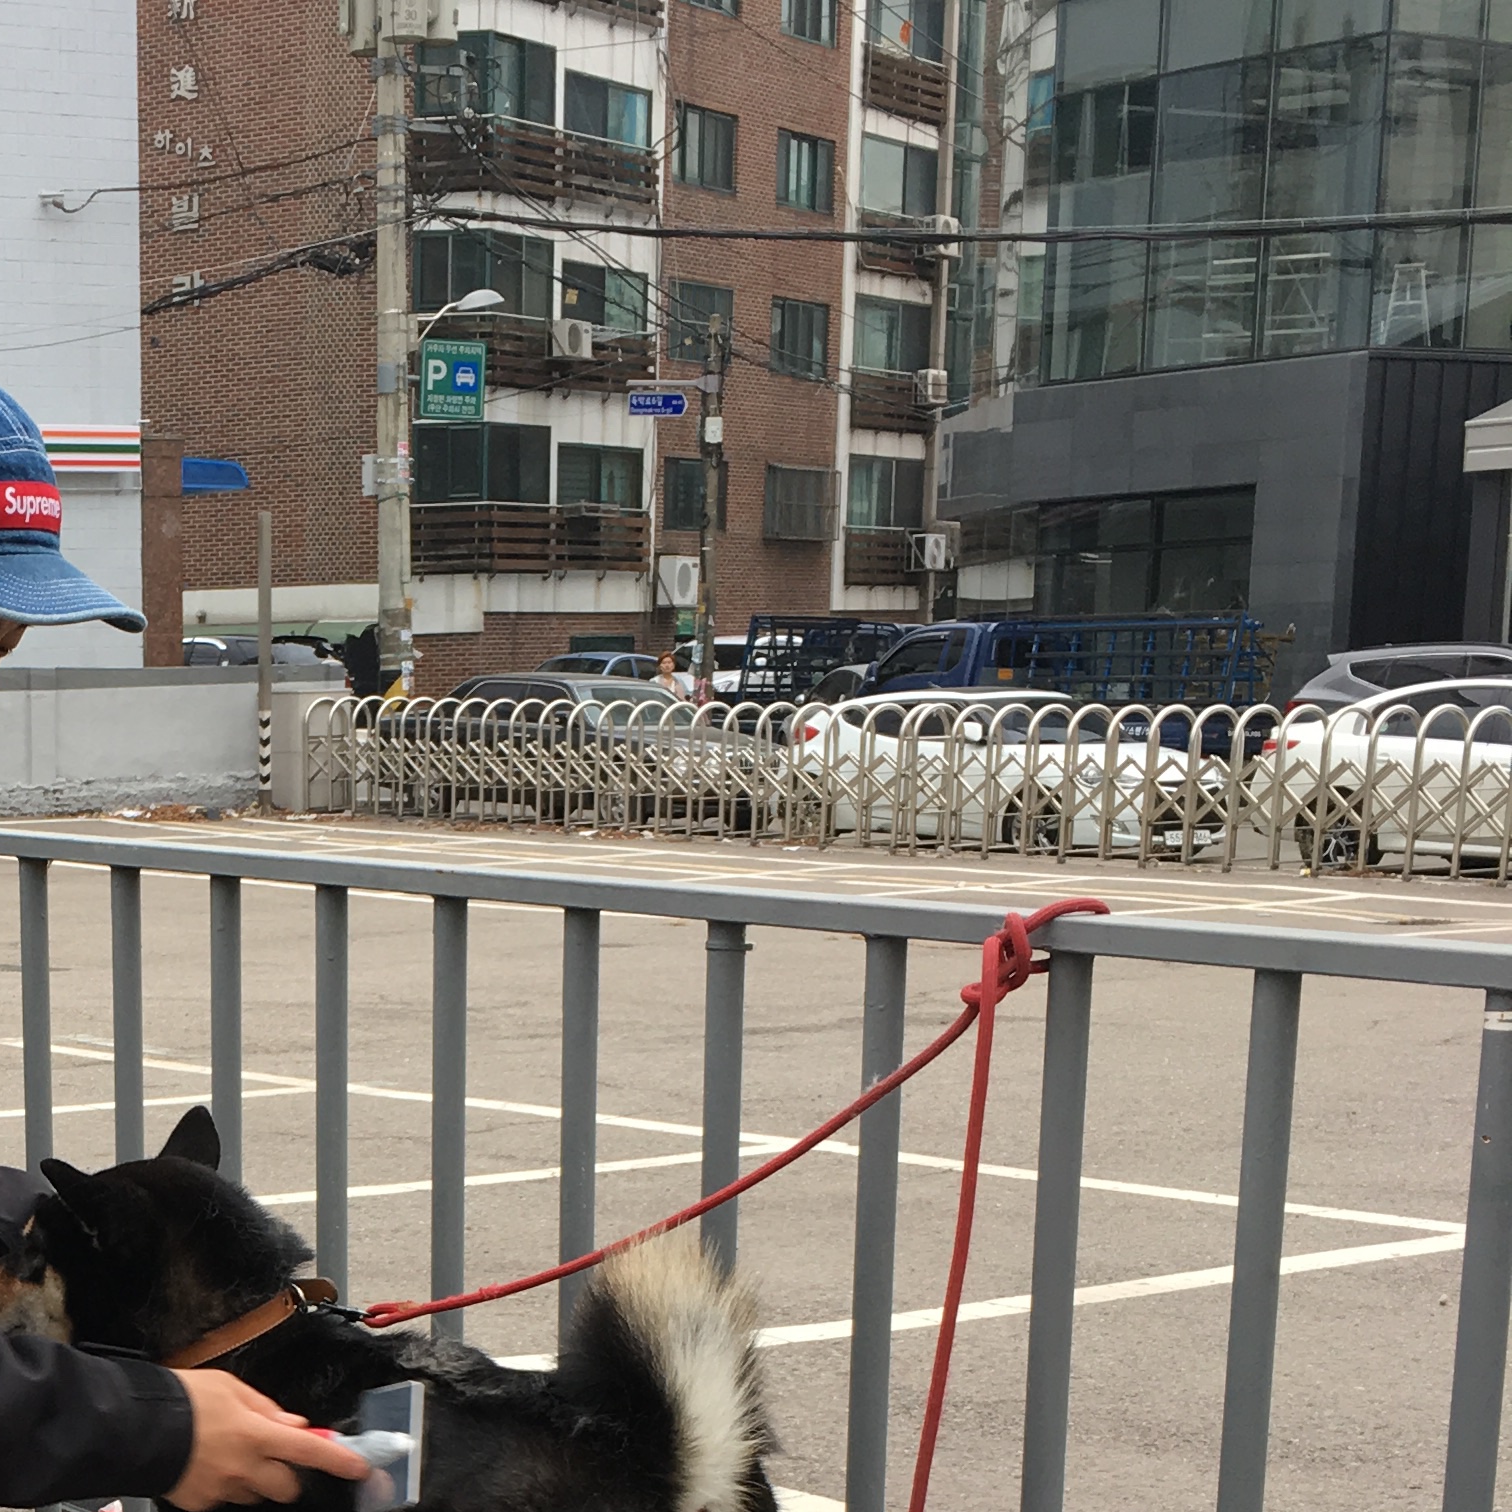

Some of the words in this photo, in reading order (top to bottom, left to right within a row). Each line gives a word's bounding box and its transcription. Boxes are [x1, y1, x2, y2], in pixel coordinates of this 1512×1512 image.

[153, 128, 216, 168] 하이츠
[427, 359, 448, 391] P
[4, 486, 61, 523] Supreme
